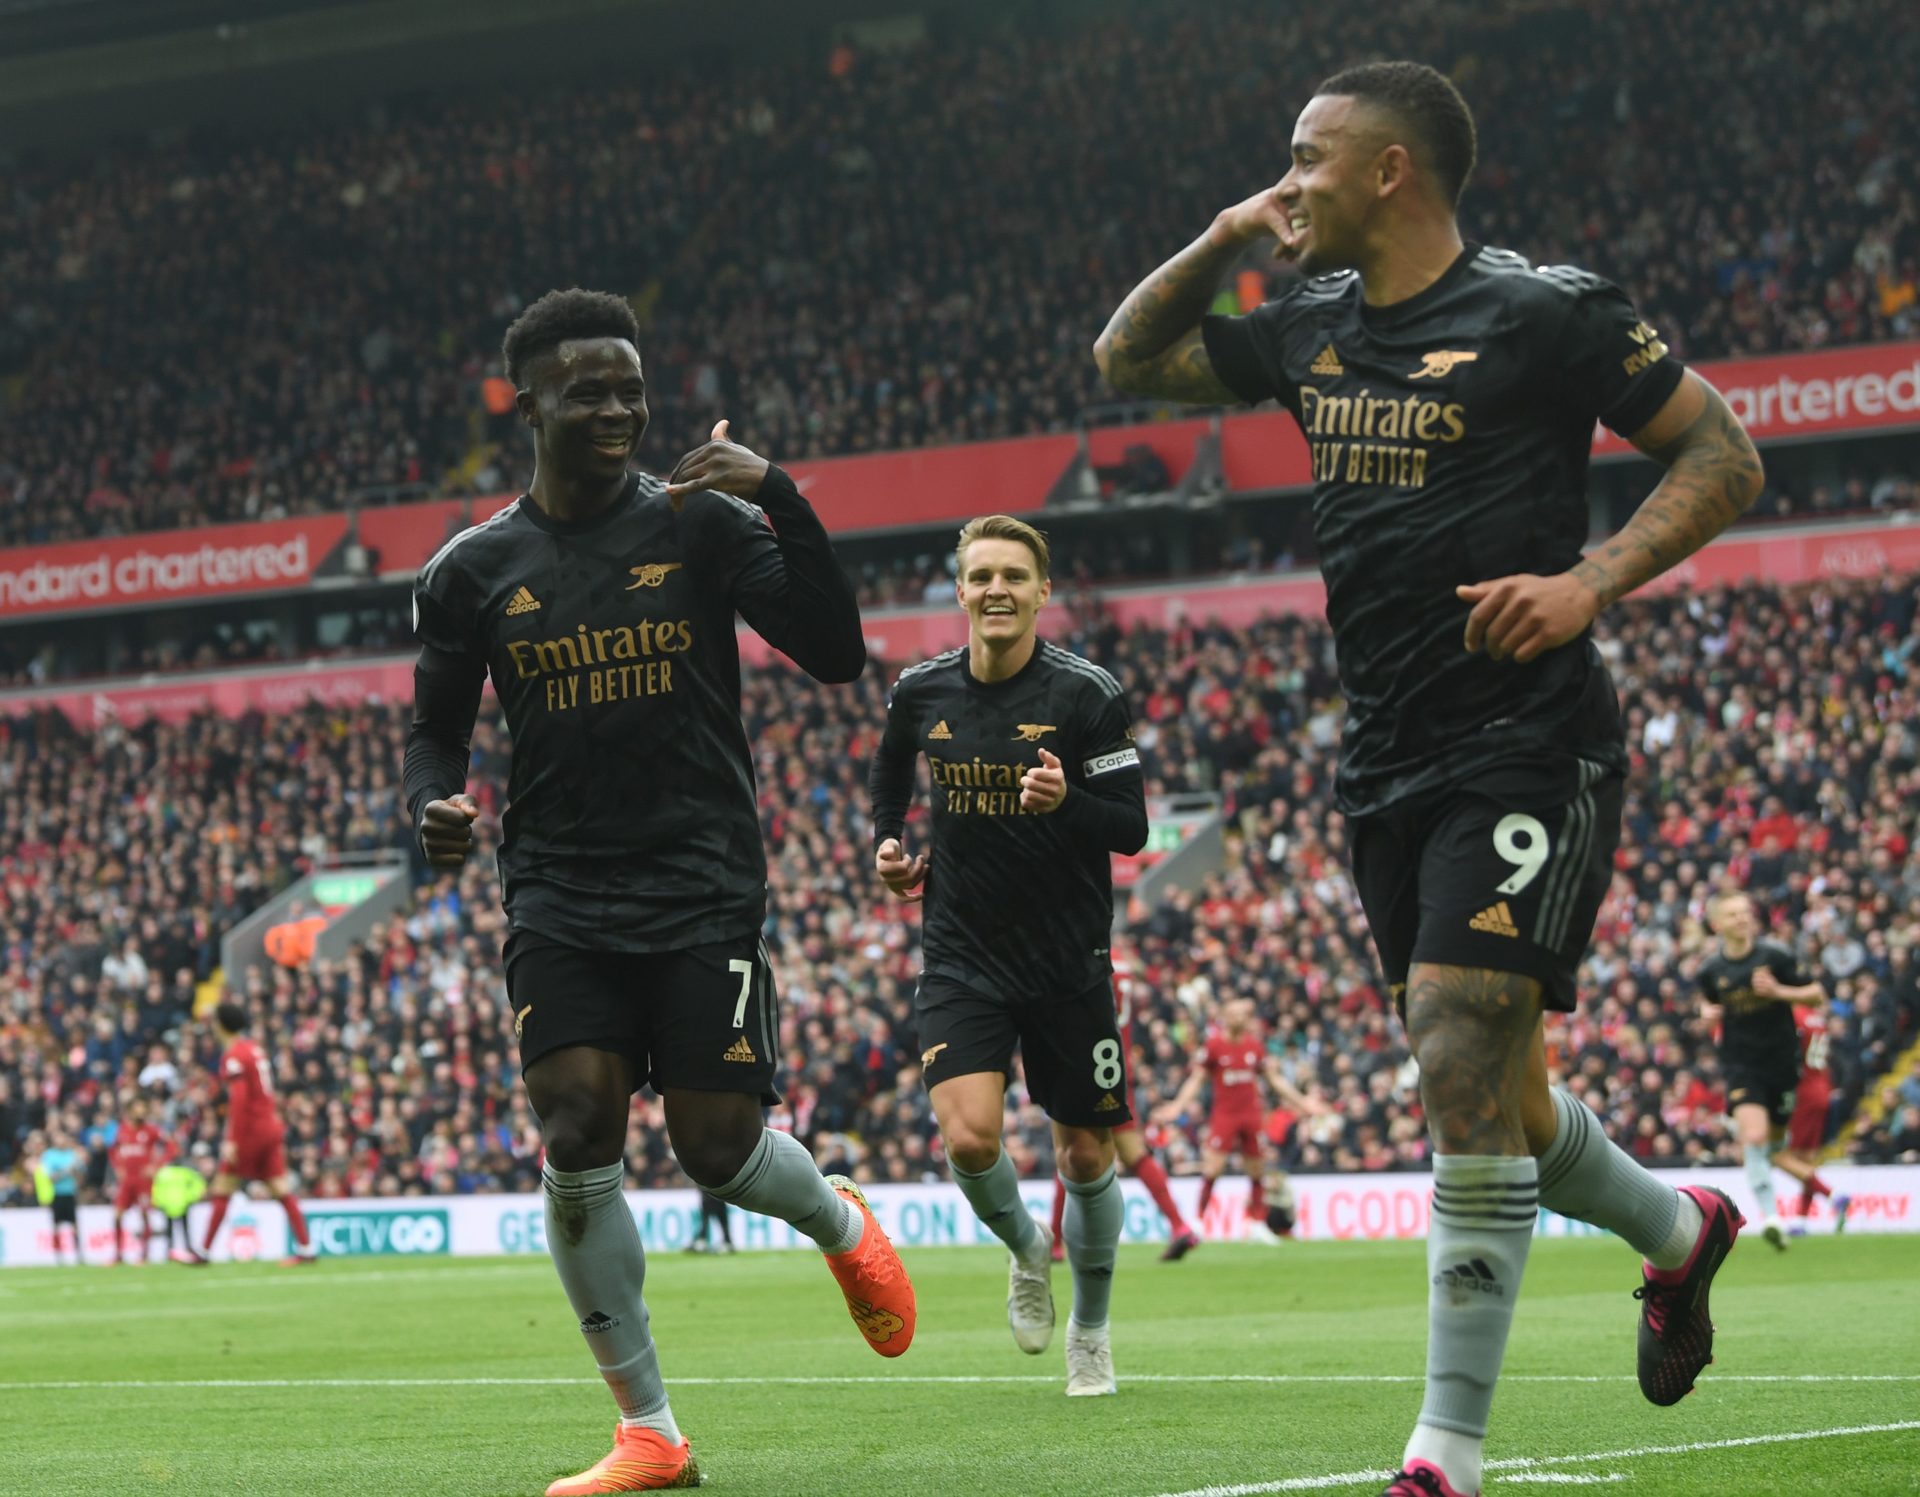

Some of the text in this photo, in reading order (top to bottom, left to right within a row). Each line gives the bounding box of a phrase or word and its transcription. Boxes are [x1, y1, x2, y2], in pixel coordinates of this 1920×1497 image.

[1300, 386, 1465, 442] Emirates
[1722, 361, 1920, 425] artered
[1312, 442, 1427, 488] FLY BETTER
[115, 533, 308, 594] chartered
[506, 601, 541, 616] adidas
[506, 617, 692, 680] Emirates
[546, 660, 673, 712] FLY BETTER
[928, 756, 1027, 788] Emirat
[1096, 752, 1136, 769] Capta
[947, 789, 971, 814] FLY
[1492, 813, 1550, 895] 9
[728, 958, 753, 1028] 7
[723, 1052, 756, 1063] adidas
[1092, 1038, 1122, 1089] 8
[500, 1211, 546, 1252] GE
[899, 1201, 957, 1242] ON
[1327, 1189, 1433, 1240] COD
[1433, 1274, 1503, 1297] adidas
